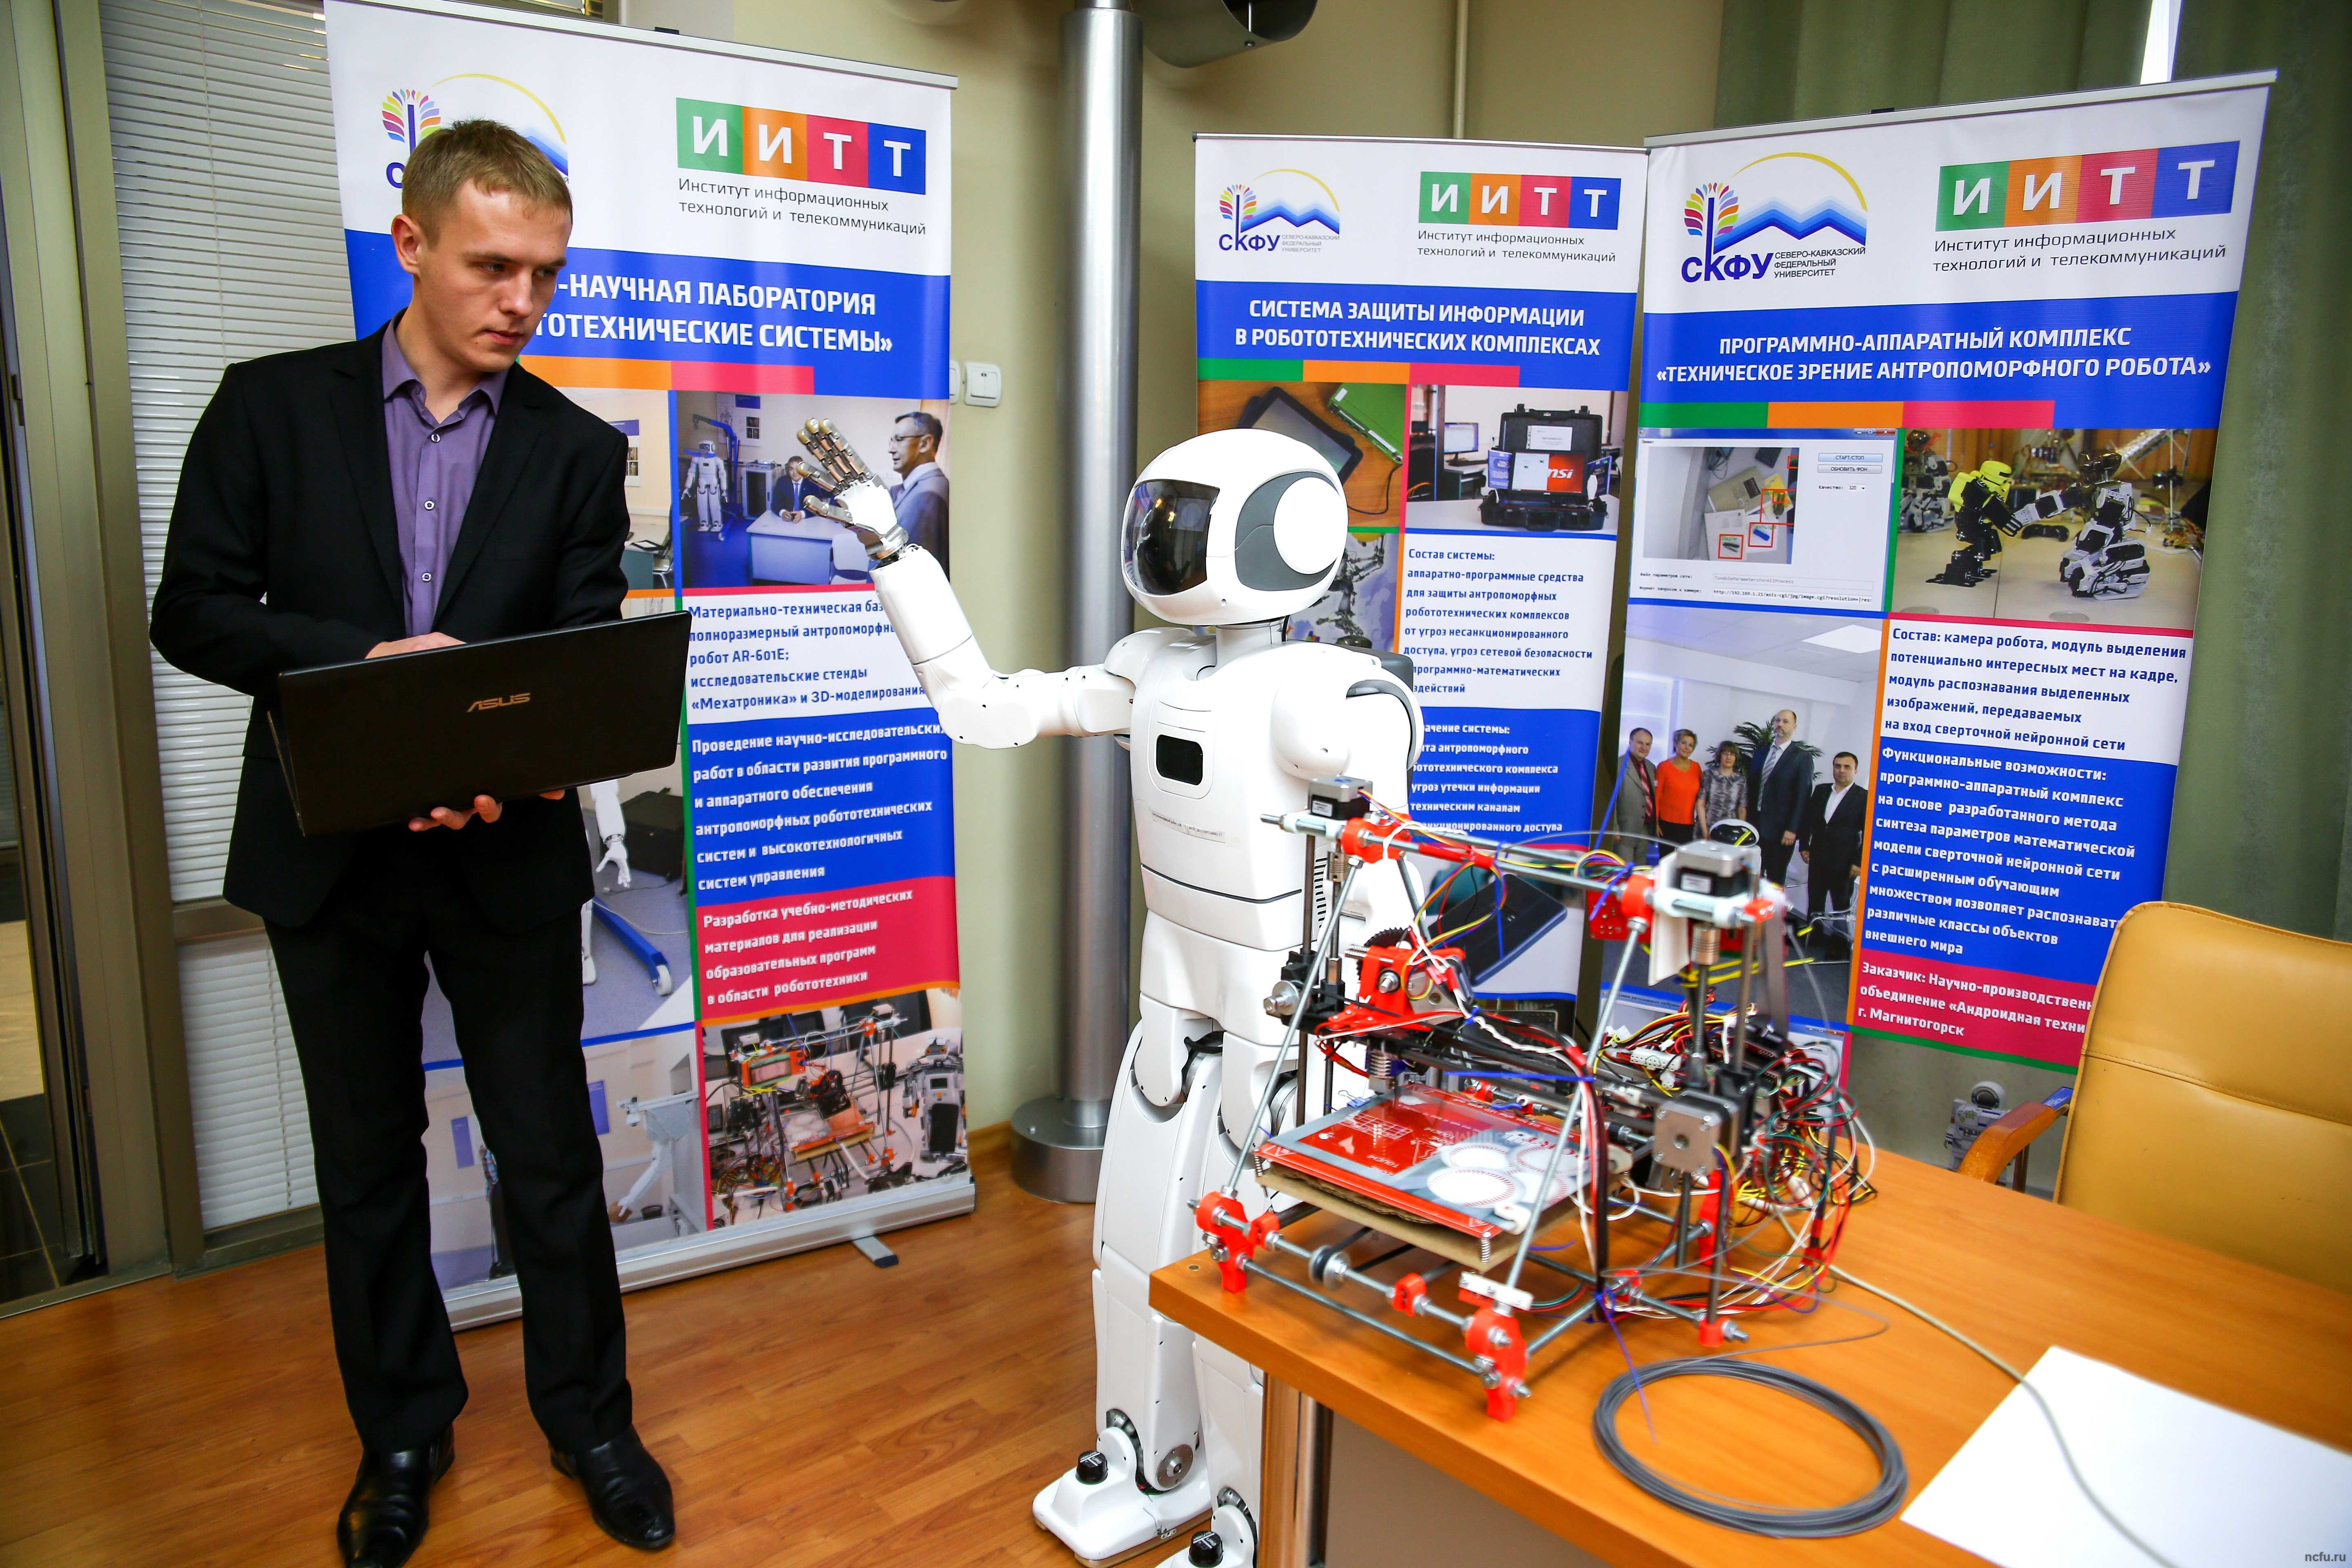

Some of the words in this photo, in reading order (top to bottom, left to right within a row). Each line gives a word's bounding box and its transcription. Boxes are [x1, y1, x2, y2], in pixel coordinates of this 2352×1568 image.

[679, 178, 750, 200] Институт
[755, 187, 888, 211] информационных
[679, 202, 767, 219] технологий
[789, 212, 925, 235] телекоммуникаций
[1219, 234, 1280, 252] СКФУ
[1418, 230, 1473, 243] Институт
[1476, 232, 1584, 245] информационных
[1935, 239, 2010, 252] Институт
[2014, 229, 2176, 250] информационных
[1417, 247, 1485, 257] технологий
[1502, 250, 1615, 263] телекоммуникаций
[1774, 258, 1836, 269] ФЕДЕРАЛЬНЫЙ
[1775, 247, 1866, 258] СЕВЕРО-КАВКАЗСКИЙ
[1933, 256, 2027, 272] технологий
[2050, 243, 2226, 266] телекоммуникаций
[1681, 252, 1774, 283] СКФУ
[1774, 268, 1836, 278] УНИВЕРСИТЕТ
[698, 281, 875, 316] ЛАБОРАТОРИЯ
[1250, 300, 1343, 319] СИСТЕМА
[1348, 302, 1434, 322] ЗАЩИТЫ
[1439, 304, 1584, 328] ИНФОРМАЦИИ
[759, 324, 893, 352] СИСТЕМЫ»
[1252, 328, 1467, 351] РОБОТОТЕХНИЧЕСКИХ
[1471, 334, 1601, 356] КОМПЛЕКСАХ
[1719, 326, 2004, 354] ПРОГРАММНО-АППАРАТНЫЙ
[2009, 327, 2132, 348] КОМПЛЕКС
[1656, 364, 1793, 382] «ТЕХНИЧЕСКОЕ
[1797, 363, 1873, 380] ЗРЕНИЕ
[1876, 359, 2099, 379] АНТРОПОМОРФНОГО
[2105, 356, 2211, 376] РОБОТА»
[1409, 548, 1444, 559] Состав
[1447, 552, 1495, 560] системы:
[1408, 570, 1535, 582] аппаратно-программные
[1538, 574, 1584, 584] средства
[1428, 590, 1467, 599] защиты
[1469, 591, 1557, 603] антропоморфных
[688, 604, 862, 620] Материально-техническая
[1406, 606, 1507, 619] робототехнических
[1510, 612, 1569, 620] комплексов
[689, 625, 799, 643] полноразмерный
[1419, 628, 1446, 638] угроз
[1449, 629, 1568, 641] несанкционированного
[1893, 628, 1940, 642] Состав:
[1944, 634, 1993, 647] камера
[1996, 635, 2047, 650] робота,
[2051, 641, 2103, 655] модуль
[2107, 644, 2186, 659] выделения
[690, 651, 729, 668] робот
[732, 648, 788, 663] AR-601E;
[1403, 647, 1448, 656] доступа,
[1450, 648, 1477, 657] угроз
[1480, 648, 1521, 657] сетевой
[1524, 648, 1592, 659] безопасности
[690, 671, 819, 688] исследовательские
[823, 668, 867, 680] стенды
[1891, 653, 1982, 668] потенциально
[1986, 659, 2068, 675] интересных
[2071, 666, 2106, 677] мест
[2130, 670, 2178, 684] кадре,
[691, 695, 797, 710] «Мехатроника»
[811, 686, 925, 703] 3D-моделирования
[1889, 675, 1935, 689] модуль
[1938, 679, 2037, 696] распознавания
[2041, 688, 2130, 703] выделенных
[467, 693, 530, 713] ASUS
[1887, 697, 1978, 715] изображений,
[1982, 706, 2082, 723] передаваемых
[1462, 724, 1510, 734] системы:
[1903, 722, 1931, 735] вход
[1935, 725, 2011, 740] сверточной
[2014, 731, 2089, 748] нейронной
[2093, 739, 2125, 751] сети
[692, 736, 773, 756] Проведение
[1438, 744, 1529, 756] антропоморфного
[693, 765, 734, 784] работ
[746, 761, 800, 776] области
[803, 757, 860, 775] развития
[862, 750, 947, 768] программного
[1505, 765, 1559, 774] комплекса
[1882, 747, 2002, 770] Функциональные
[2005, 761, 2107, 781] возможности:
[706, 789, 789, 808] аппаратного
[792, 782, 873, 800] обеспечения
[1411, 783, 1439, 793] угроз
[1440, 784, 1475, 793] утечки
[1477, 783, 1540, 795] информации
[1880, 772, 2049, 800] программно-аппаратный
[2052, 791, 2124, 807] комплекс
[695, 815, 810, 837] антропоморфных
[813, 801, 932, 827] робототехнических
[1410, 803, 1475, 811] техническим
[1477, 804, 1521, 813] каналам
[1896, 797, 1942, 812] основе
[1949, 803, 2060, 825] разработанного
[2063, 816, 2117, 832] метода
[1523, 823, 1562, 833] доступа
[1875, 817, 1927, 833] синтеза
[1930, 824, 2011, 843] параметров
[2014, 834, 2135, 858] математической
[697, 849, 746, 864] систем
[762, 830, 902, 856] высокотехнологичных
[1874, 840, 1922, 855] модели
[1925, 847, 2003, 865] сверточной
[2006, 856, 2083, 876] нейронной
[2086, 867, 2120, 881] сети
[698, 875, 747, 891] систем
[749, 866, 825, 887] управления
[1882, 864, 1975, 886] расширенным
[1978, 875, 2060, 898] обучающим
[703, 908, 779, 929] Разработка
[780, 890, 913, 920] учебно-методических
[1869, 885, 1952, 906] множеством
[1955, 898, 2025, 916] позволяет
[704, 933, 780, 954] материалов
[808, 920, 878, 943] реализации
[1867, 907, 1936, 927] различные
[1939, 919, 1990, 934] классы
[1992, 924, 2058, 945] объектов
[1865, 930, 1927, 948] внешнего
[1930, 940, 1963, 956] мира
[706, 955, 817, 981] образовательных
[820, 945, 876, 966] программ
[1862, 961, 1926, 983] Заказчик:
[717, 987, 769, 1004] области
[774, 971, 868, 998] робототехники
[1860, 984, 1946, 1010] объединение
[1949, 1001, 2041, 1026] «Андроидная
[1870, 1007, 1965, 1037] Магнитогорск
